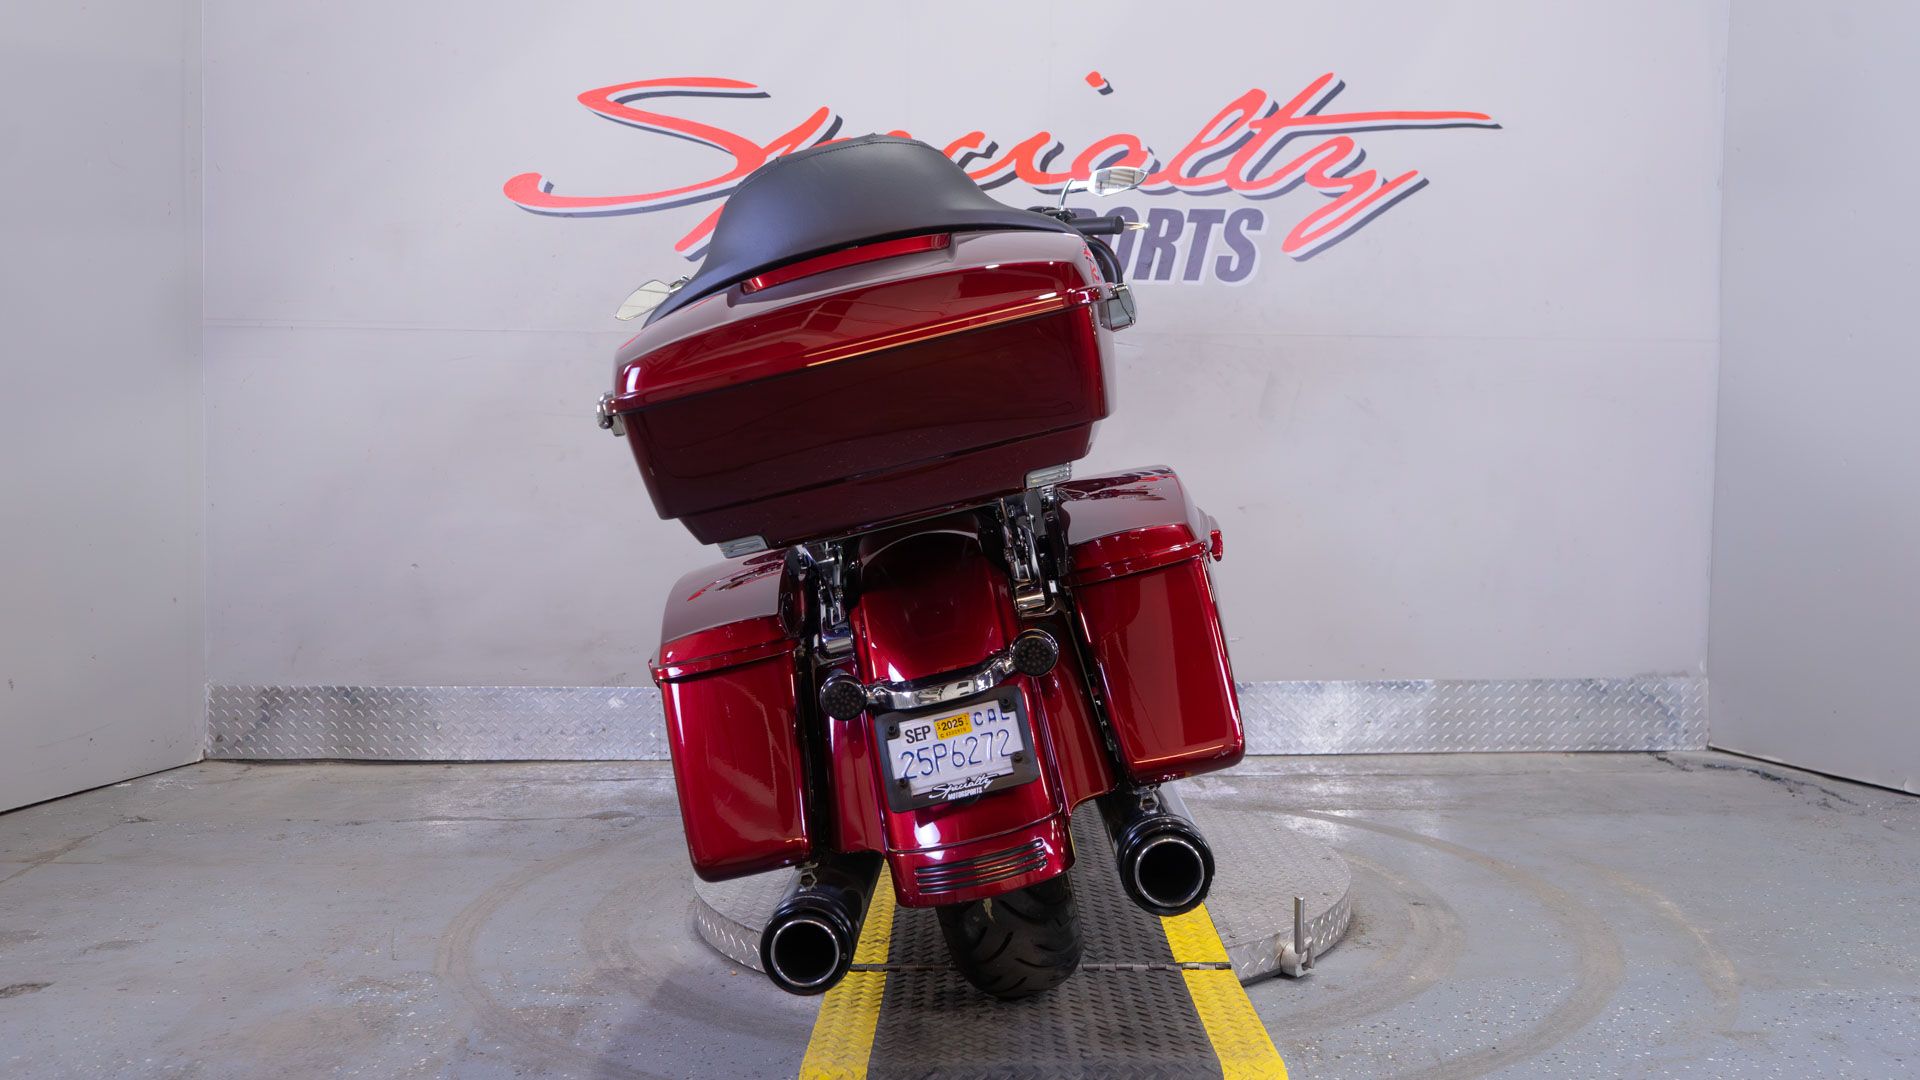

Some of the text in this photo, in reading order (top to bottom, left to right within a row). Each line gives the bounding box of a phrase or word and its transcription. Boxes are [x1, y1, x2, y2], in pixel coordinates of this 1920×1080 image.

[503, 72, 1502, 261] Scialty
[904, 725, 931, 744] SEP
[941, 717, 964, 731] 2025
[973, 708, 1011, 727] CAL
[900, 729, 1013, 780] 25P6272
[928, 773, 999, 799] Specialty
